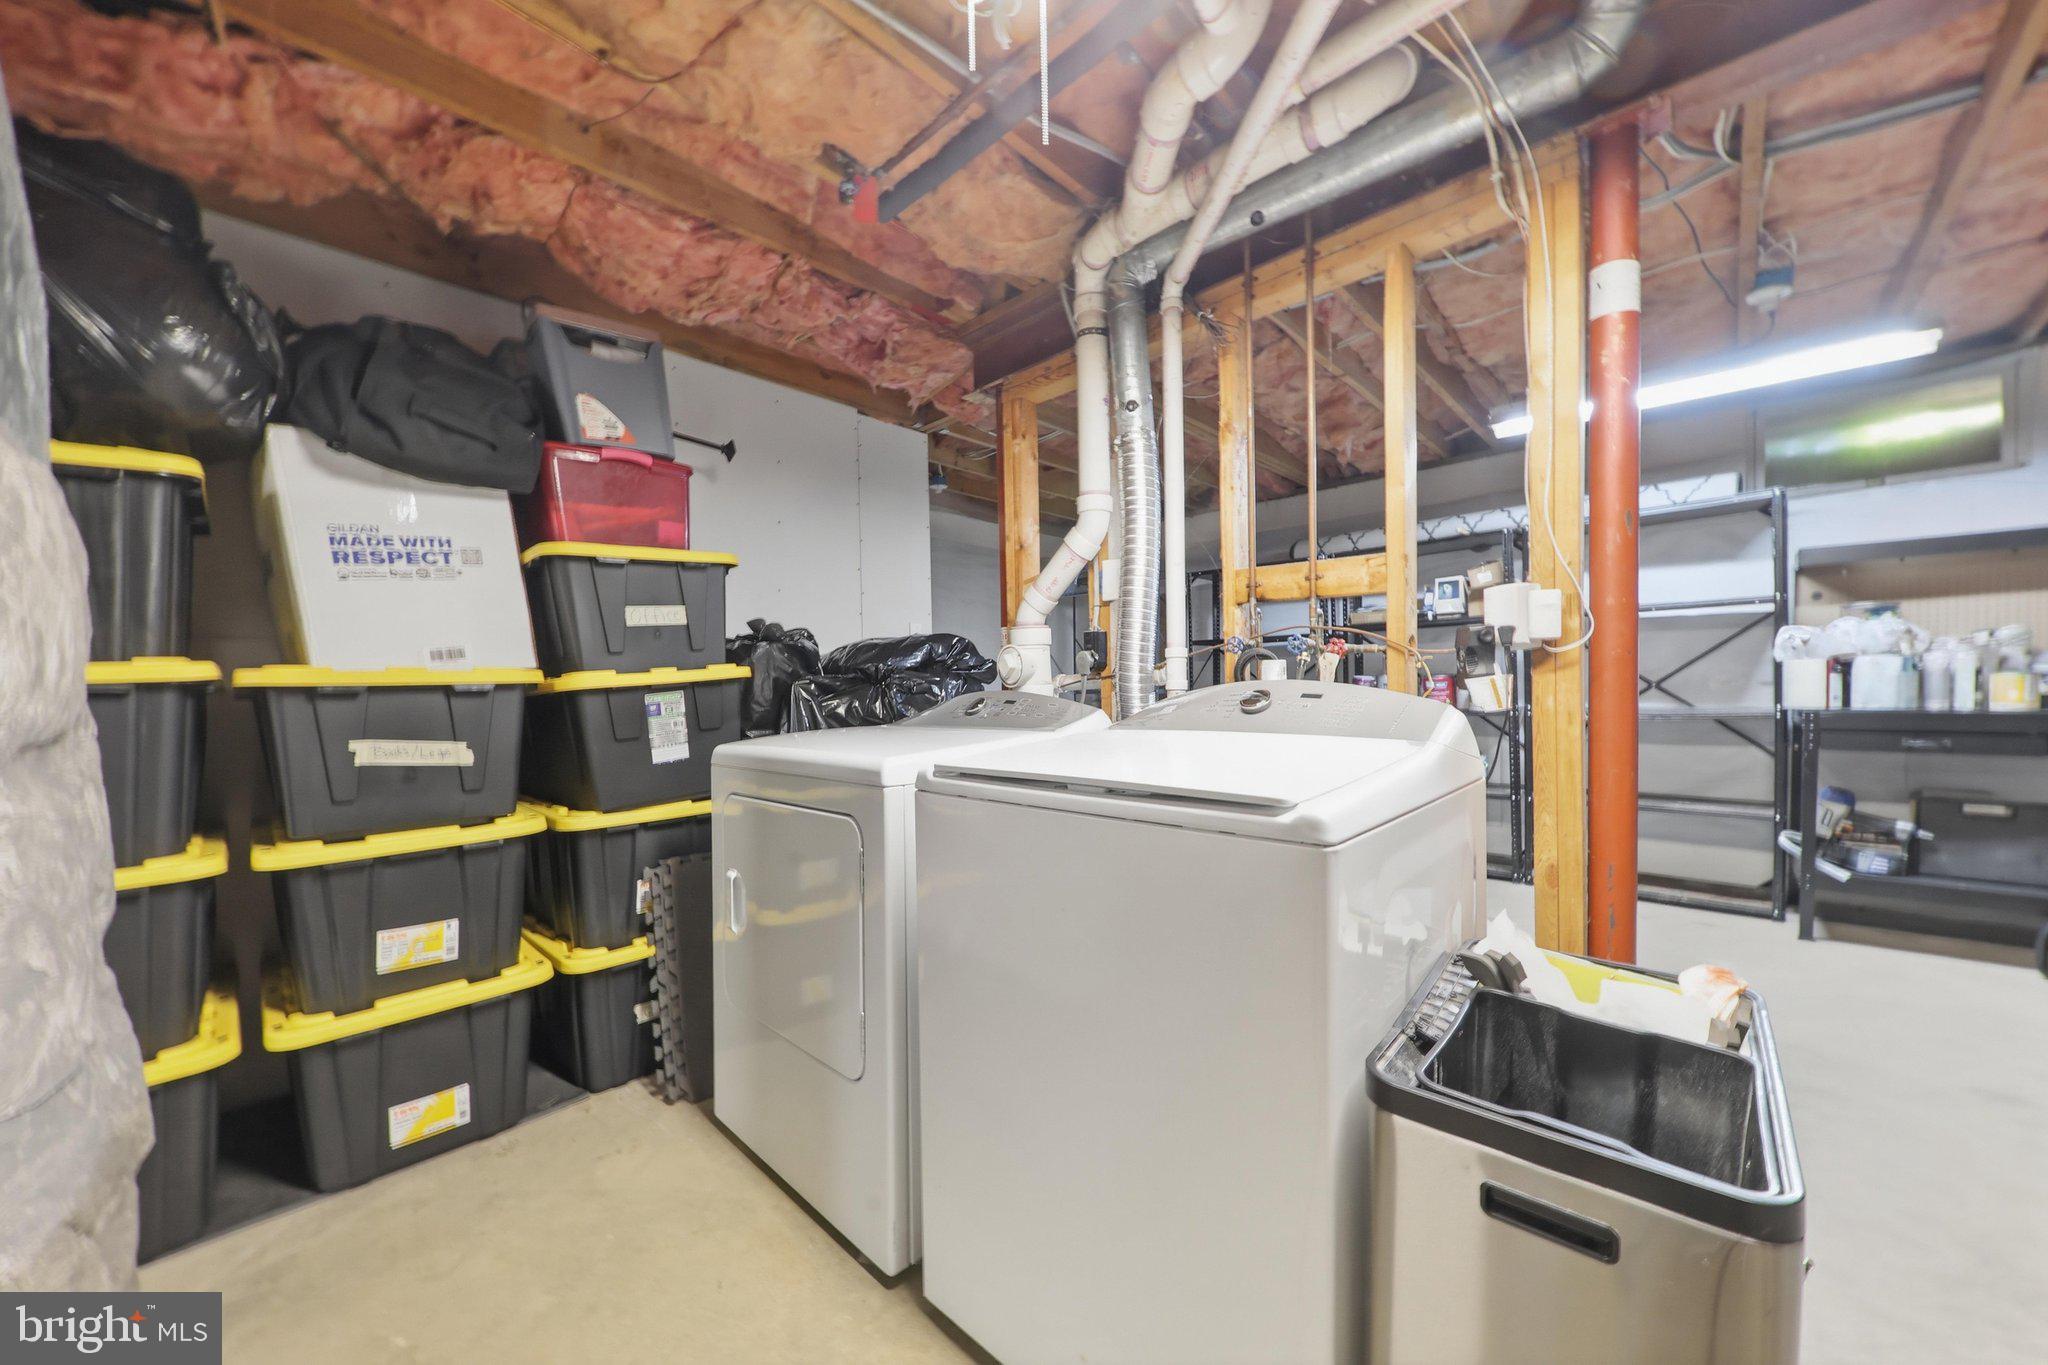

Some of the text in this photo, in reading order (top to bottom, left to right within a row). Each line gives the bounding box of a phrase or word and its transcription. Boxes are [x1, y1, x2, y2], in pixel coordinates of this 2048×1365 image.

[326, 522, 380, 534] GILDAN
[328, 534, 452, 548] MADE WITH
[331, 549, 455, 565] RESPECT
